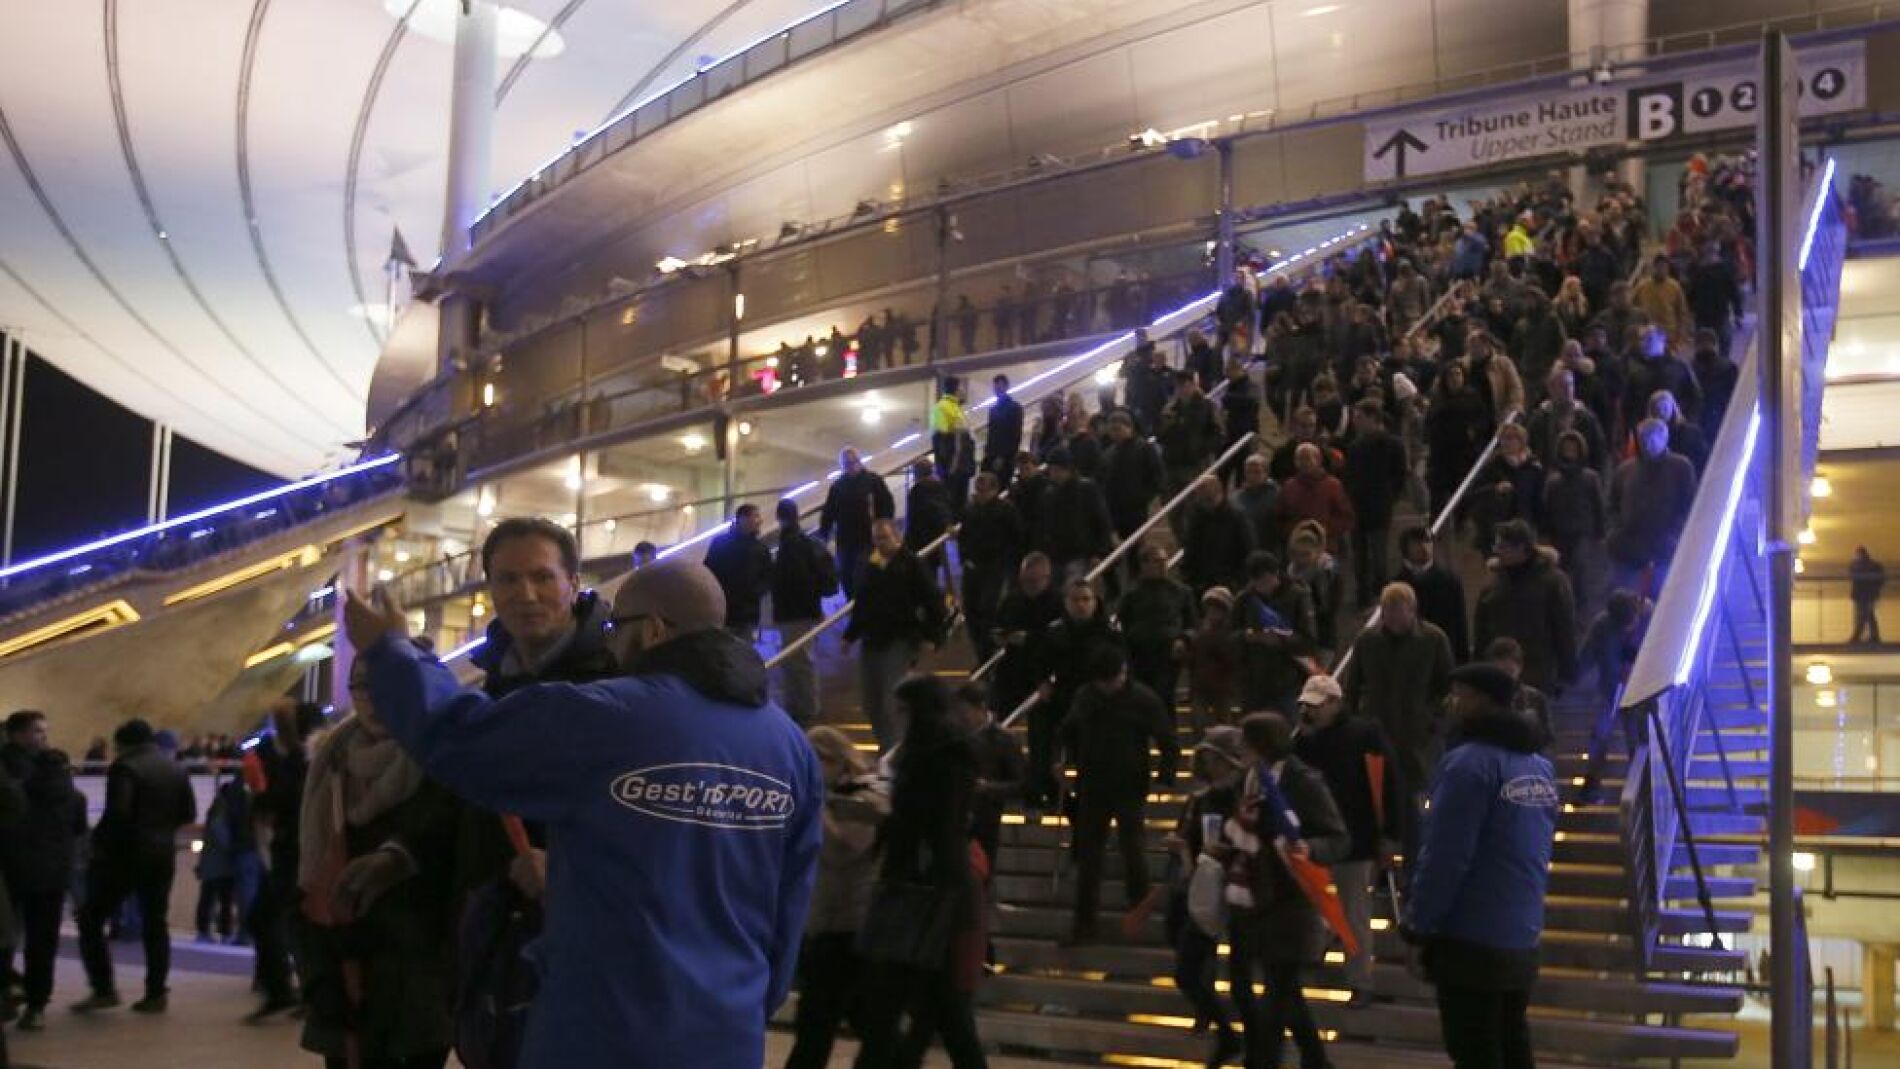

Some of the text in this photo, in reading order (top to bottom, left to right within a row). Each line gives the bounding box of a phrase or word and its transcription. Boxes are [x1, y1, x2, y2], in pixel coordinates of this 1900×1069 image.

[1435, 96, 1617, 141] Tribune Haute
[1638, 93, 1676, 140] B
[1470, 117, 1617, 163] Upper Stand
